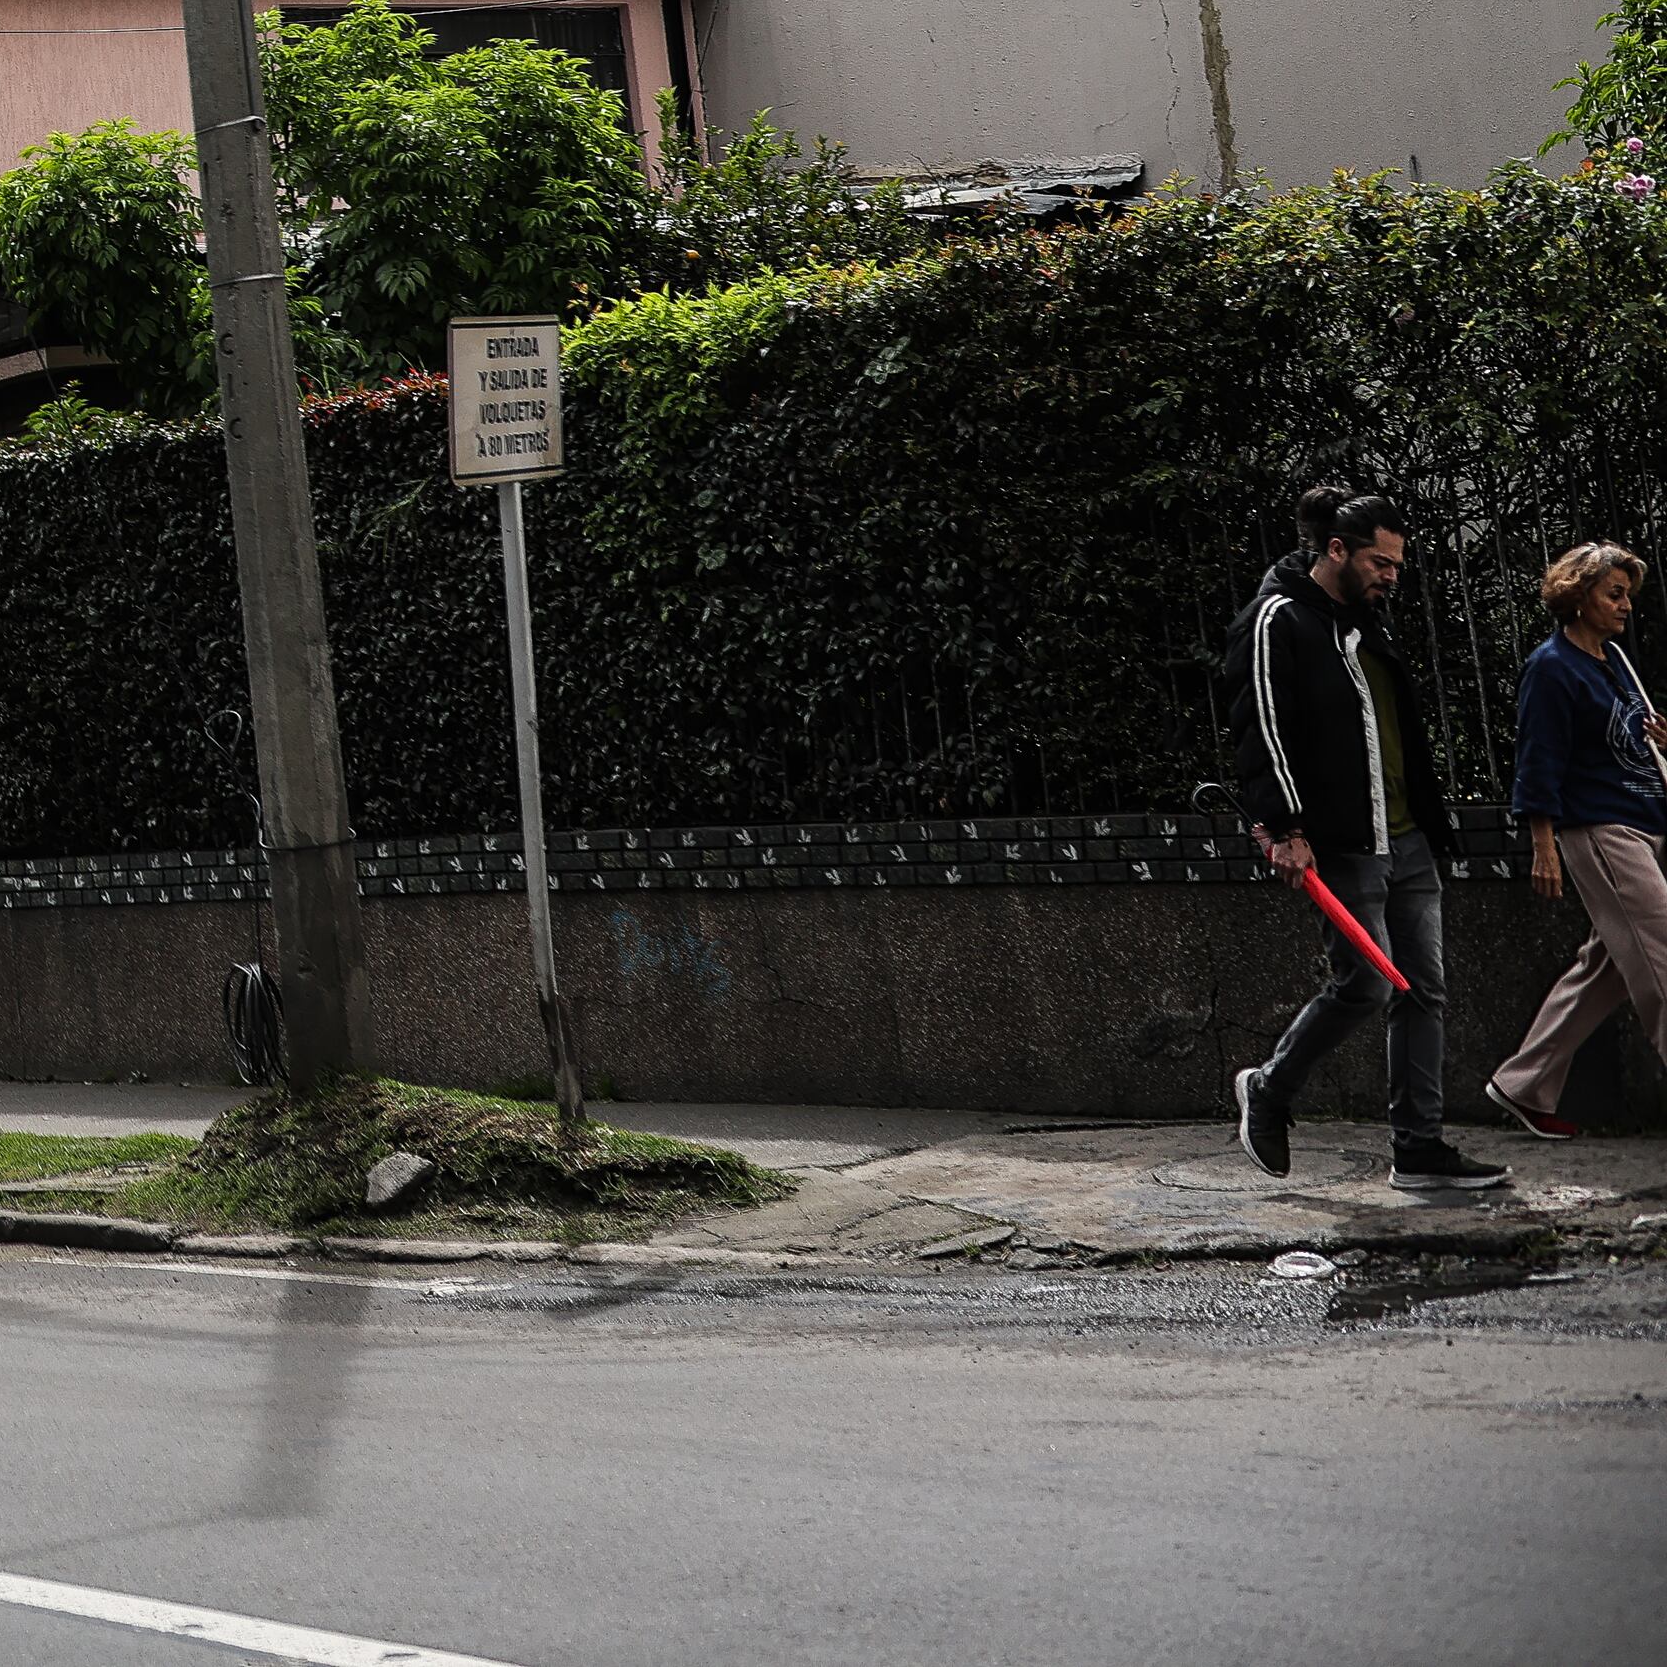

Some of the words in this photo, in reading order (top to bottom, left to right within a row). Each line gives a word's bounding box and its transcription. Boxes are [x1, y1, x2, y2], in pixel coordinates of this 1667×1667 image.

[486, 336, 540, 359] ENTRADA
[477, 370, 488, 392] Y
[489, 368, 529, 391] SALIDA
[531, 366, 548, 389] DE
[479, 399, 547, 424] VOLQUETAS
[476, 434, 487, 457] A
[488, 435, 503, 457] 80
[504, 430, 549, 455] METROS
